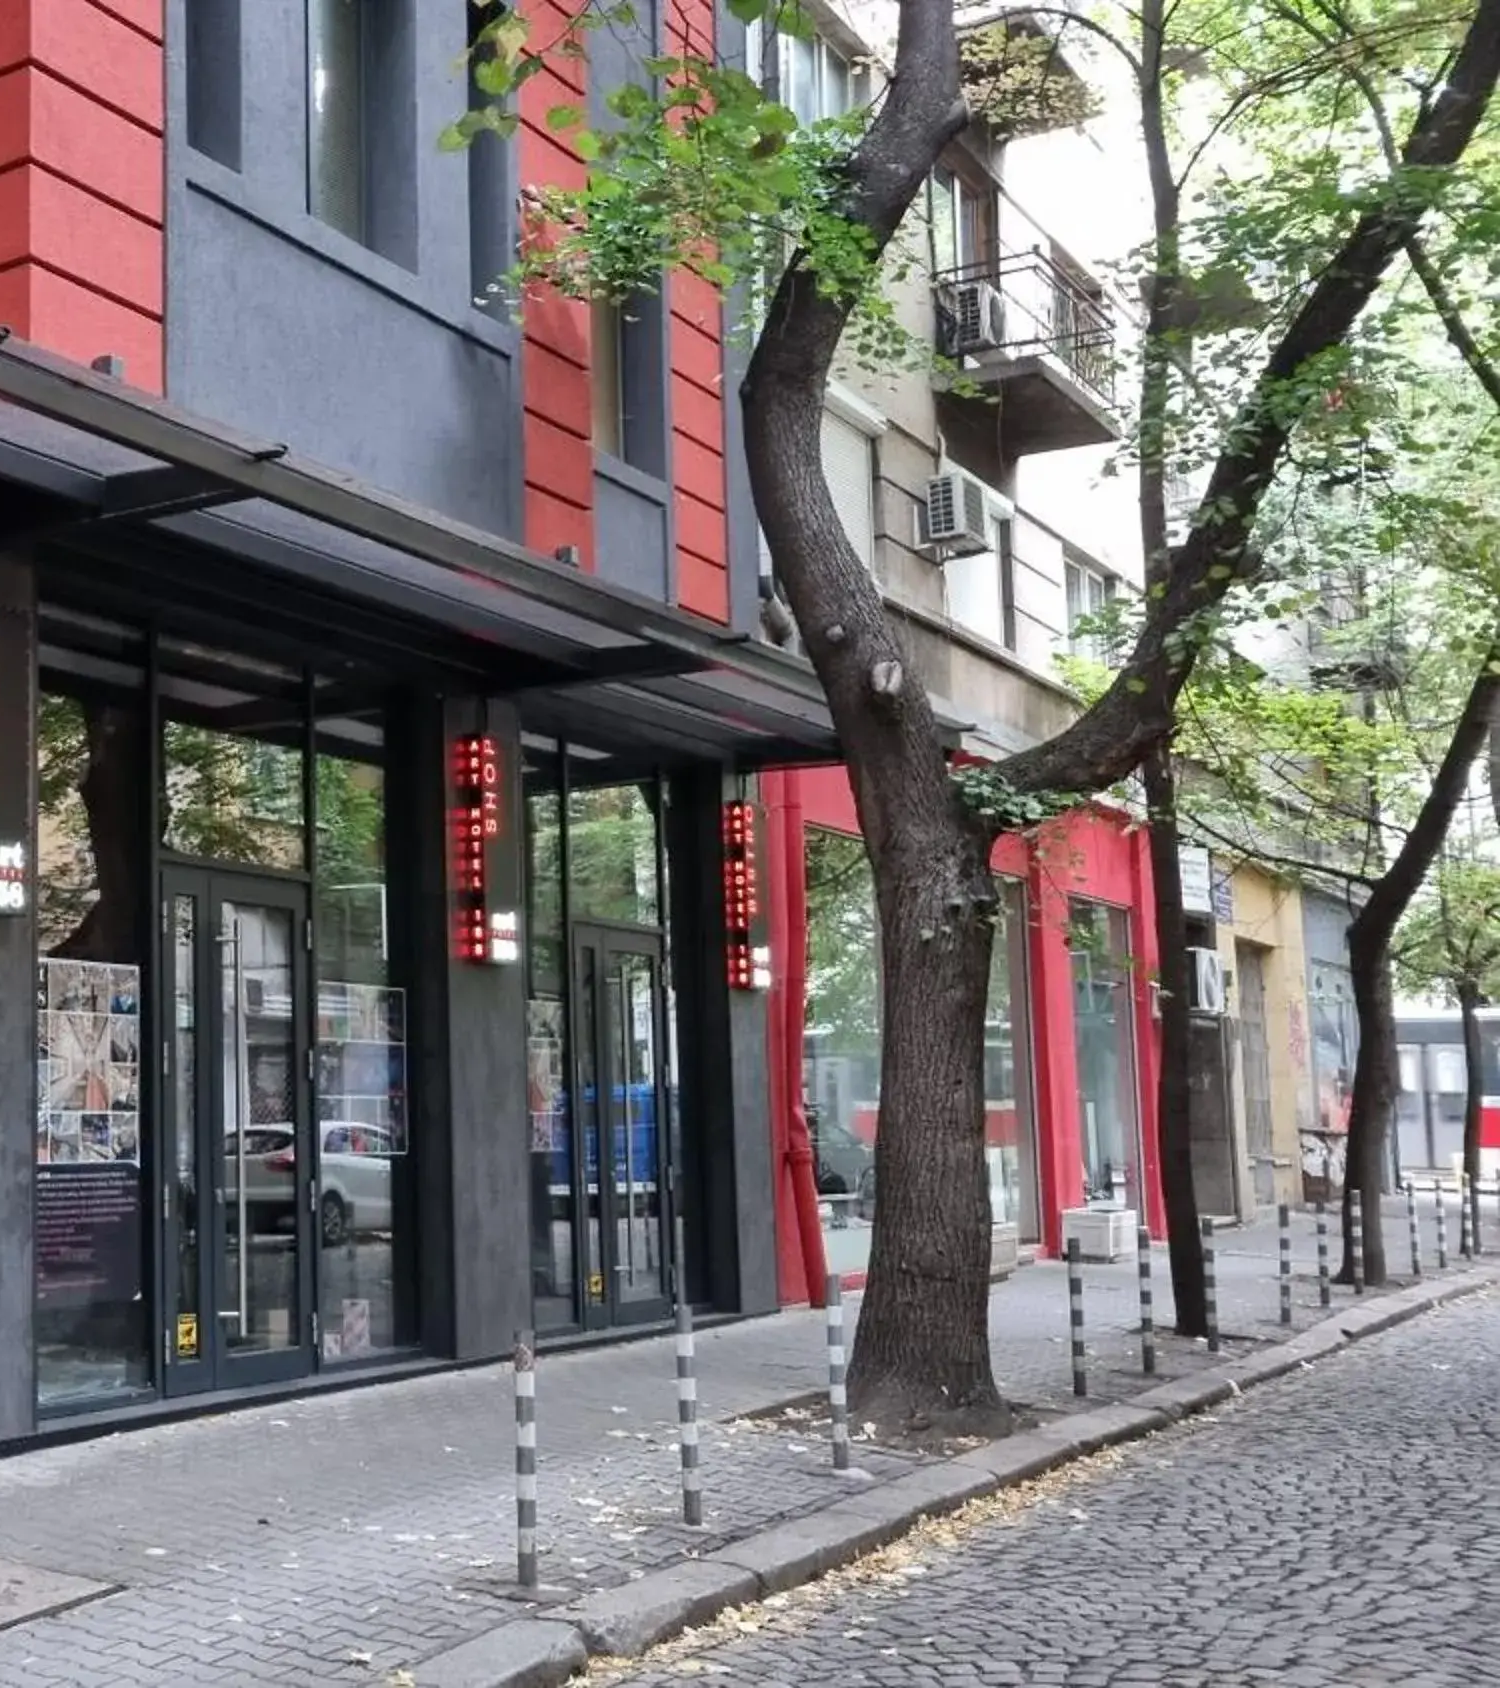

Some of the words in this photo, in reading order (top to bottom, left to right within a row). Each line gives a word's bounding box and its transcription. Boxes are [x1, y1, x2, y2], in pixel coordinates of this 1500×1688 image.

[469, 740, 480, 785] ART
[482, 739, 498, 834] SHOP
[471, 807, 482, 888] HOTEL
